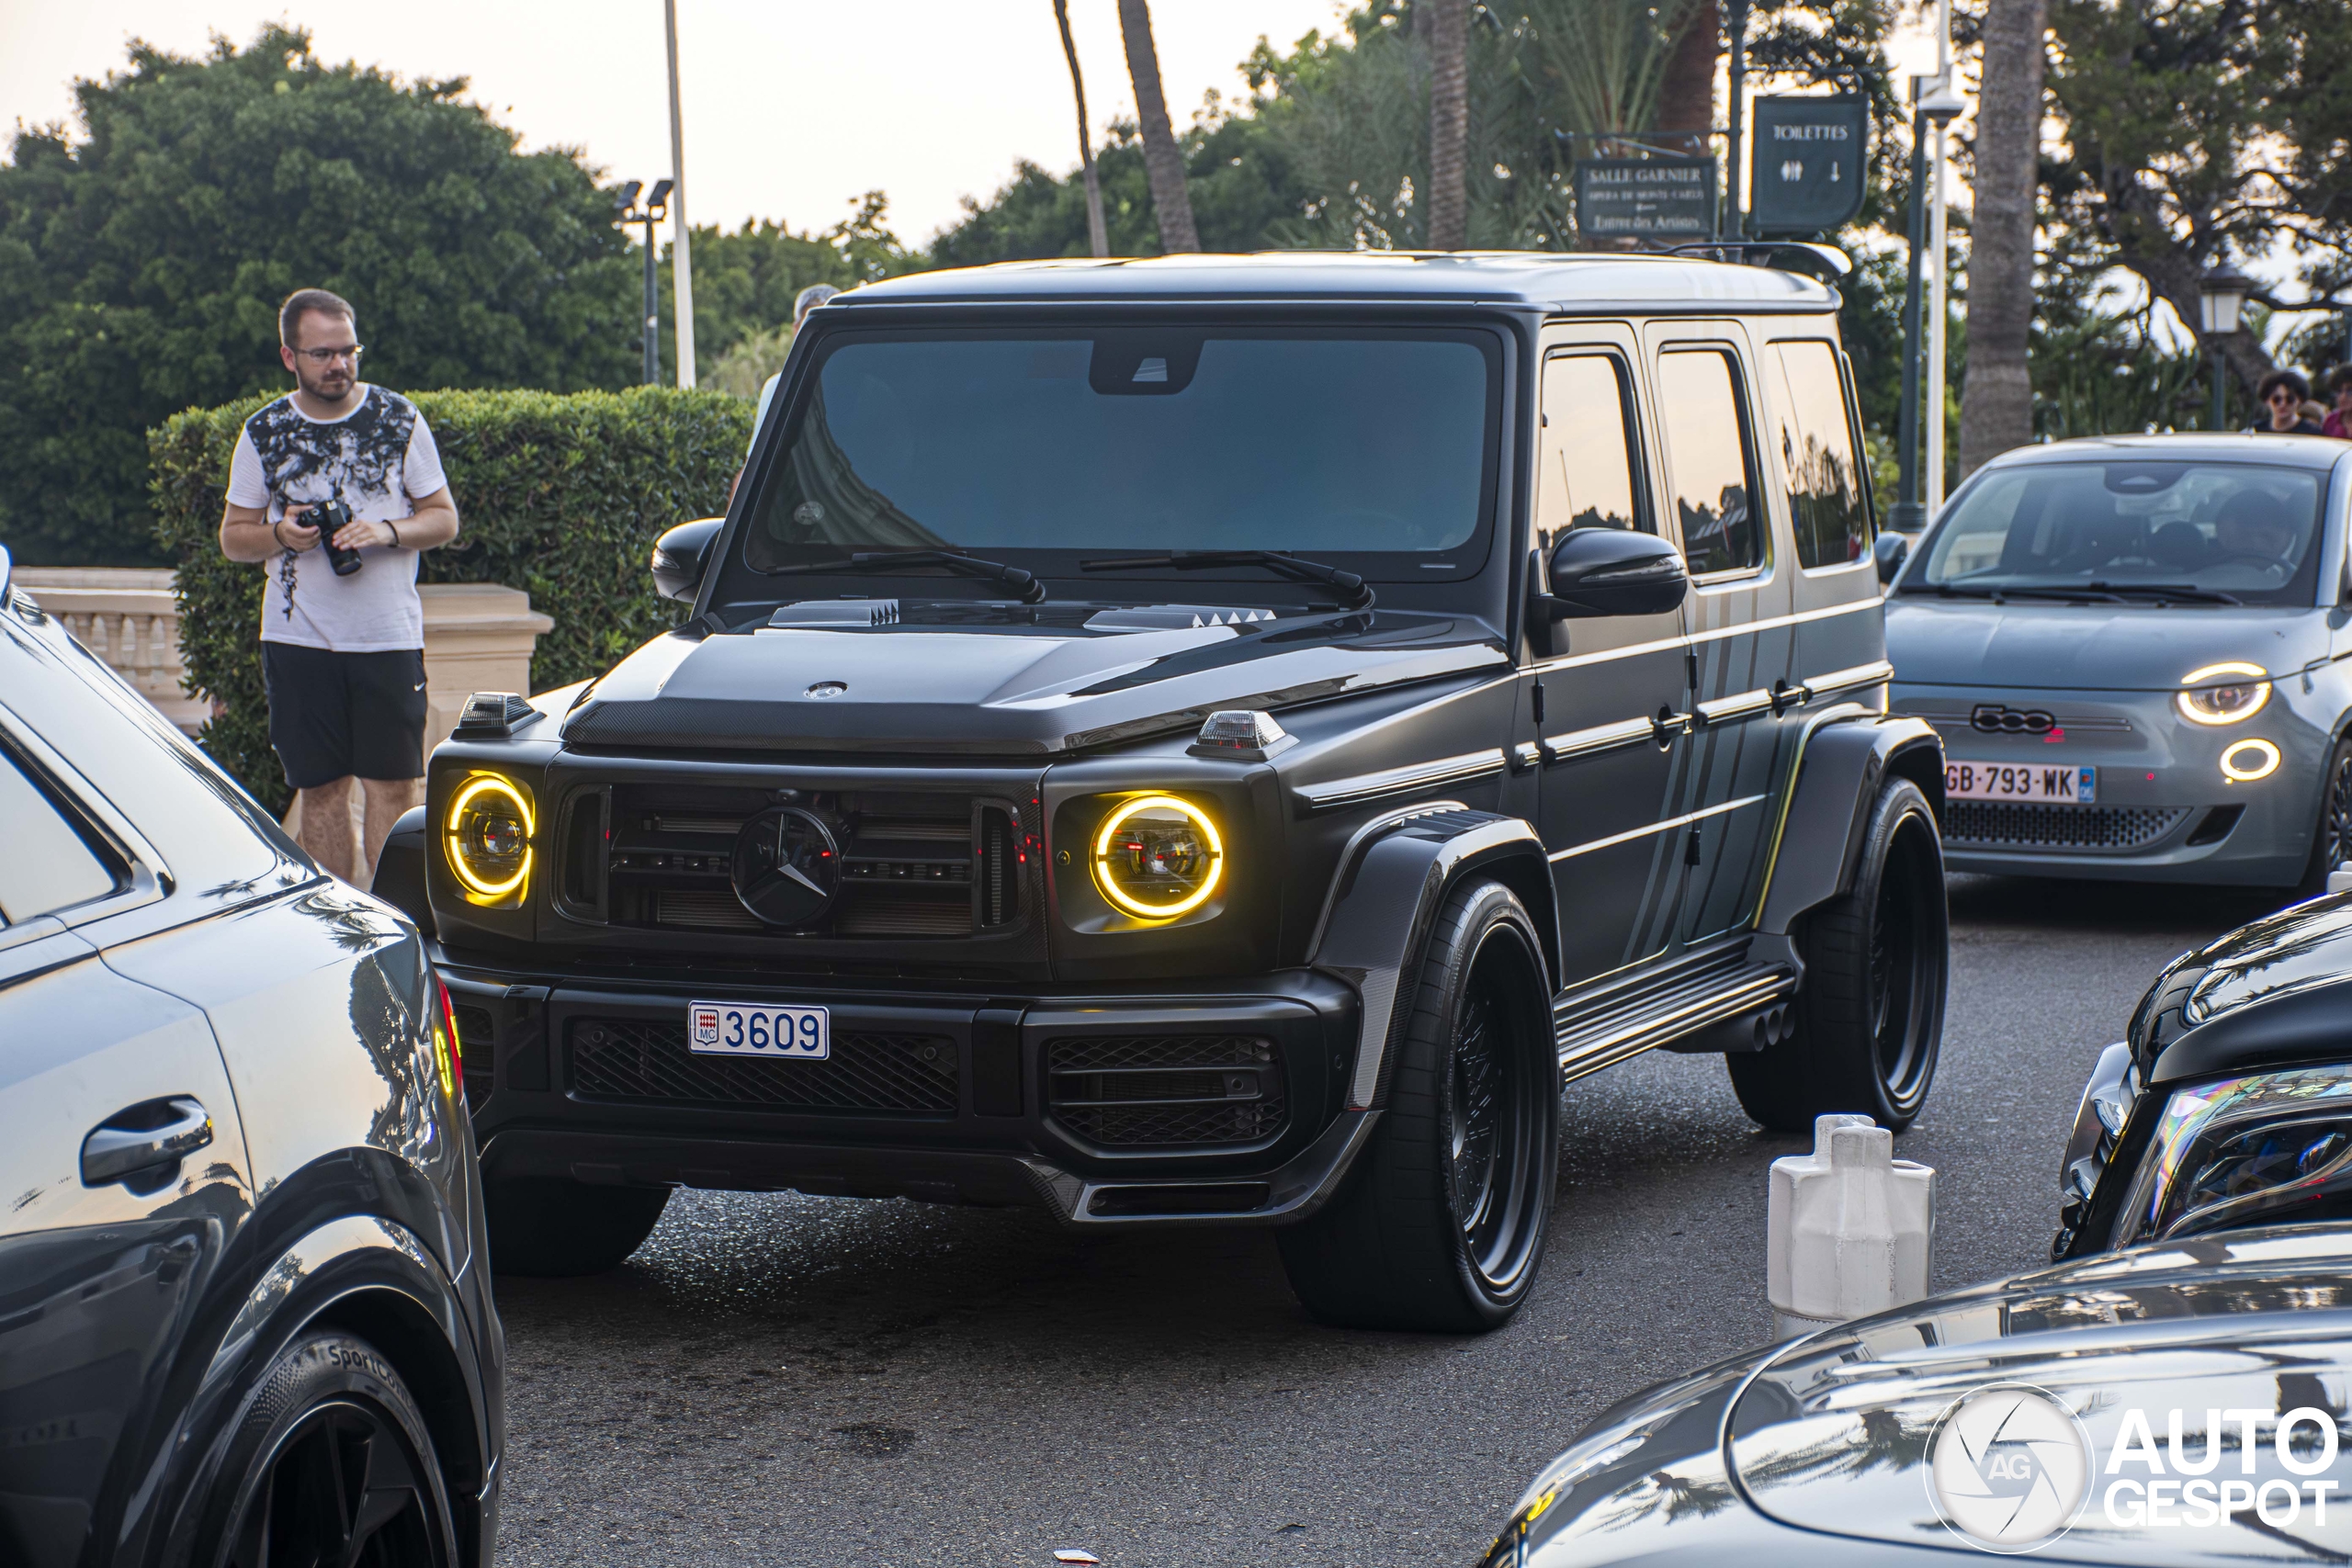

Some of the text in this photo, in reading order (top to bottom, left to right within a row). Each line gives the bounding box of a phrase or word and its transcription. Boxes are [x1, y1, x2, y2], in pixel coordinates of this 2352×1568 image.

[1773, 124, 1849, 141] TOILETTES
[1589, 167, 1702, 184] SALLE GARNIER
[1972, 705, 2055, 733] 500
[700, 1010, 820, 1052] MC 3609
